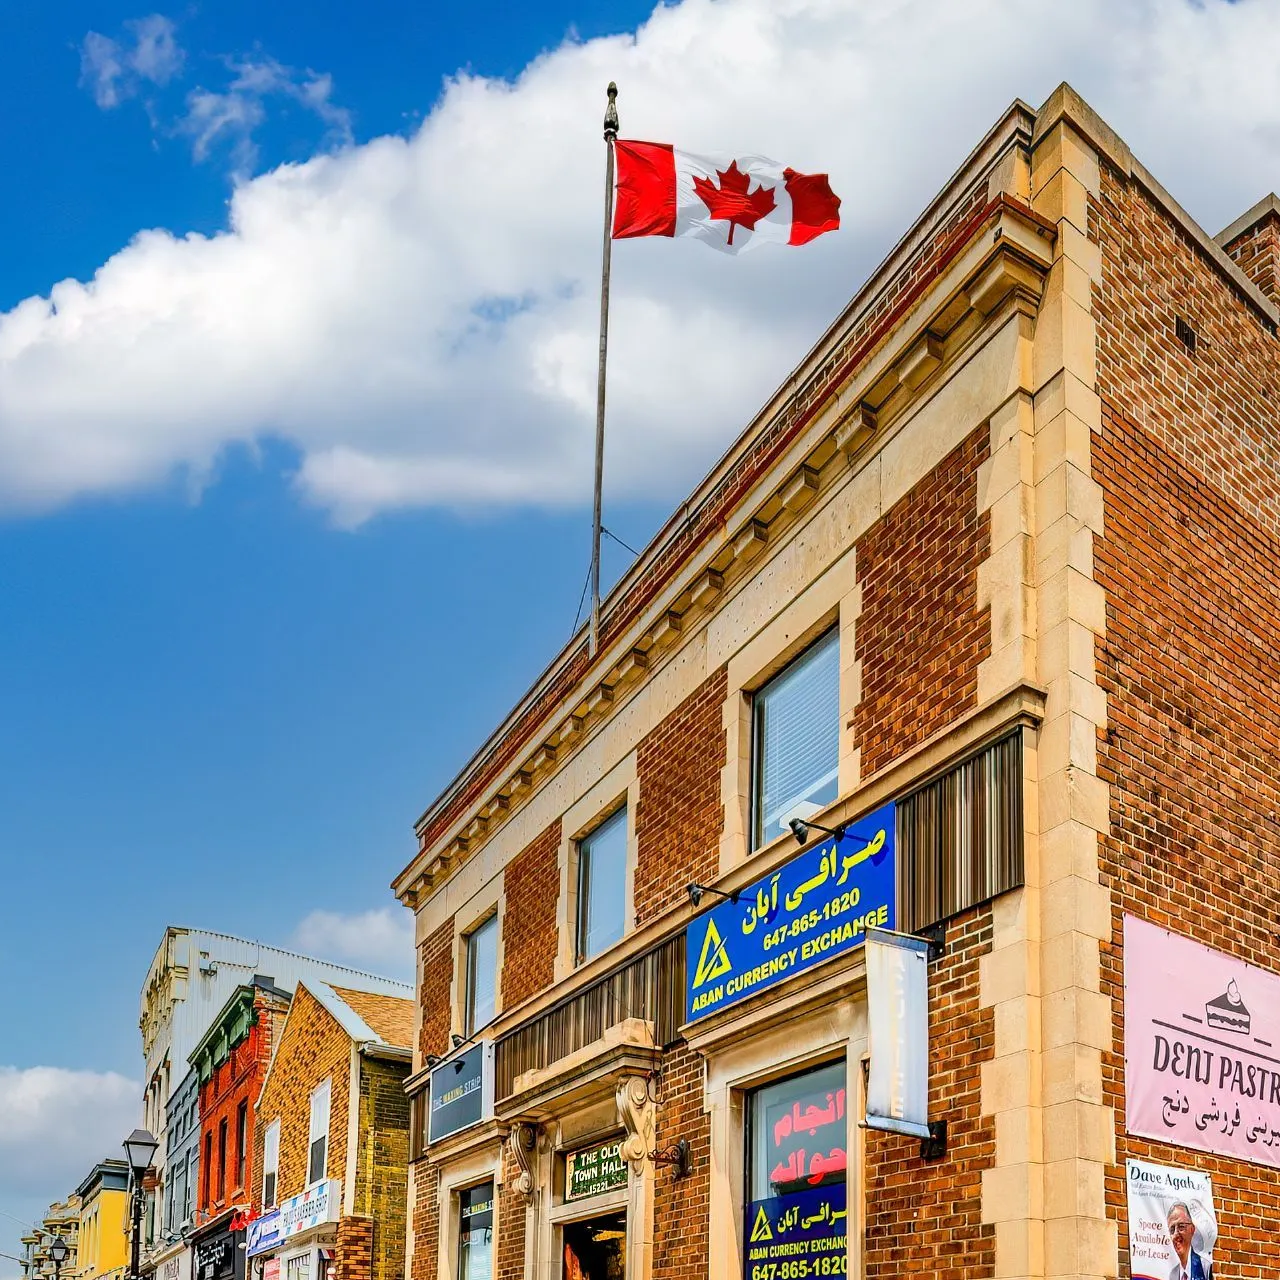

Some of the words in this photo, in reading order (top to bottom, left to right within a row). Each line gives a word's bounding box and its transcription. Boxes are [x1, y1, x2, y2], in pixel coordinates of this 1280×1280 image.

[785, 829, 887, 911] صرافی
[741, 873, 781, 935] آبان
[763, 887, 860, 950] 647-865-1820
[691, 984, 724, 1013] ABAN
[726, 949, 797, 996] CURRENCY
[801, 904, 888, 960] EXCHANGE
[774, 1089, 845, 1147] انجام
[1162, 1090, 1190, 1127] دنج
[1195, 1098, 1241, 1136] فروشی
[580, 1152, 598, 1167] THE
[601, 1144, 621, 1160] OLD
[574, 1166, 598, 1183] TOWN
[601, 1160, 627, 1176] HALL
[1130, 1166, 1162, 1184] Dave
[1165, 1173, 1196, 1191] Agah
[777, 1205, 800, 1233] آبان
[1138, 1217, 1163, 1231] Space
[749, 1246, 768, 1260] ABAN
[769, 1240, 810, 1258] CURRENCY
[811, 1235, 848, 1253] EXCHAN
[1132, 1232, 1171, 1246] Available
[1132, 1245, 1147, 1257] For
[1148, 1248, 1170, 1260] Lease
